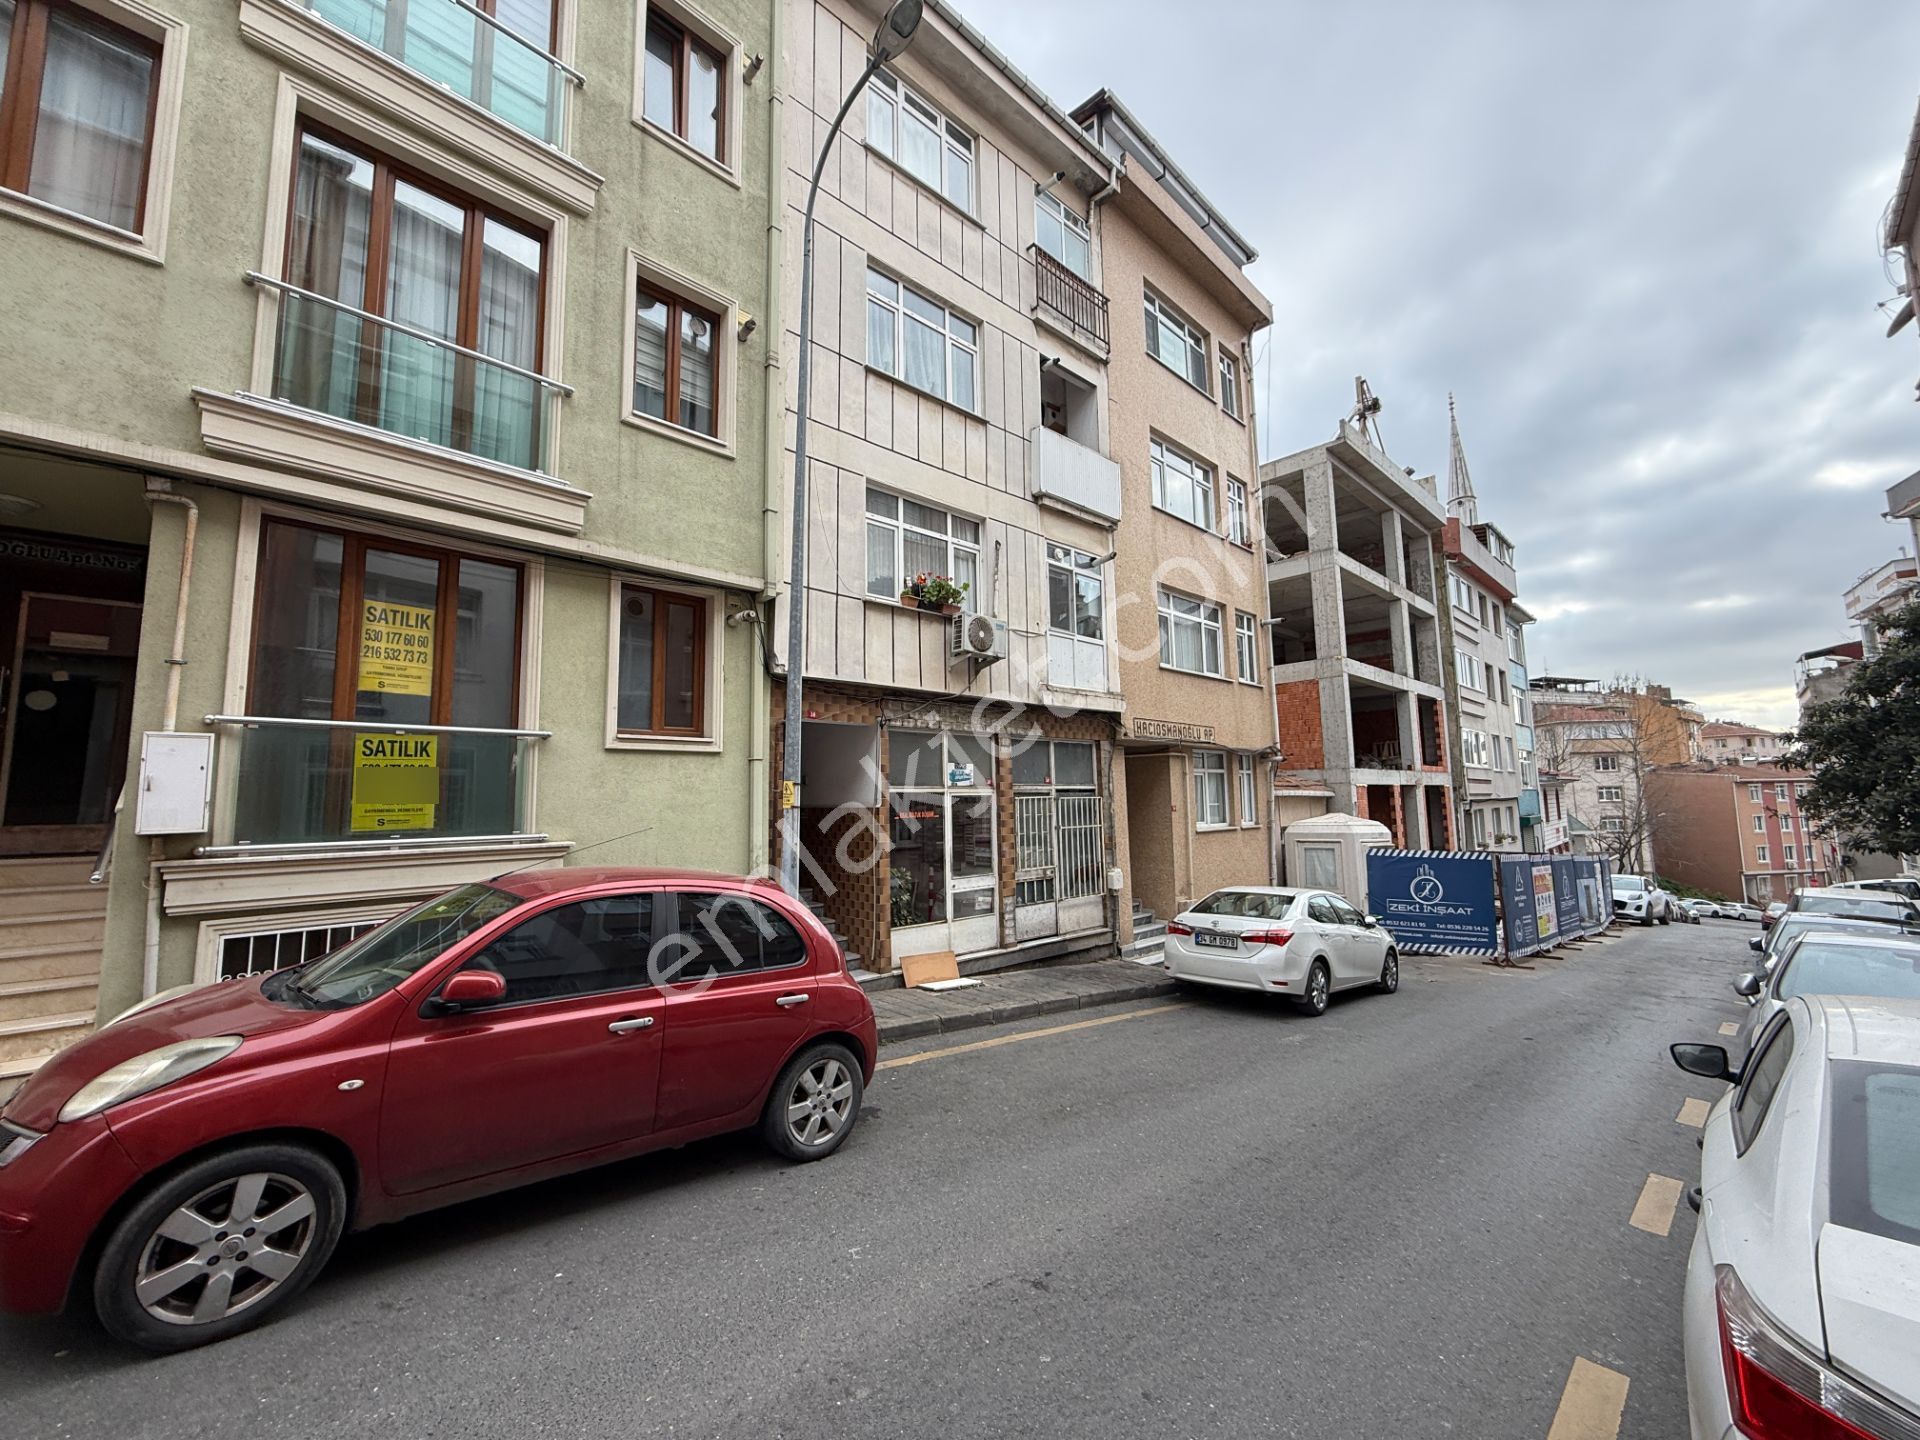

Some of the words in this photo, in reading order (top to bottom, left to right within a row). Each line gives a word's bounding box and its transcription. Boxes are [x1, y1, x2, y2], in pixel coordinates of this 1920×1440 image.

[365, 605, 432, 630] SATILIK
[364, 628, 383, 643] 530
[385, 631, 402, 645] 177
[404, 633, 416, 647] 60
[417, 635, 429, 649] 60
[363, 644, 382, 659] 216
[384, 647, 401, 662] 532
[403, 649, 414, 663] 73
[416, 651, 428, 664] 73
[361, 738, 431, 758] SATILIK
[1389, 903, 1419, 913] ZEKİ
[1423, 904, 1474, 916] İNŞAAT
[1199, 934, 1207, 943] 34
